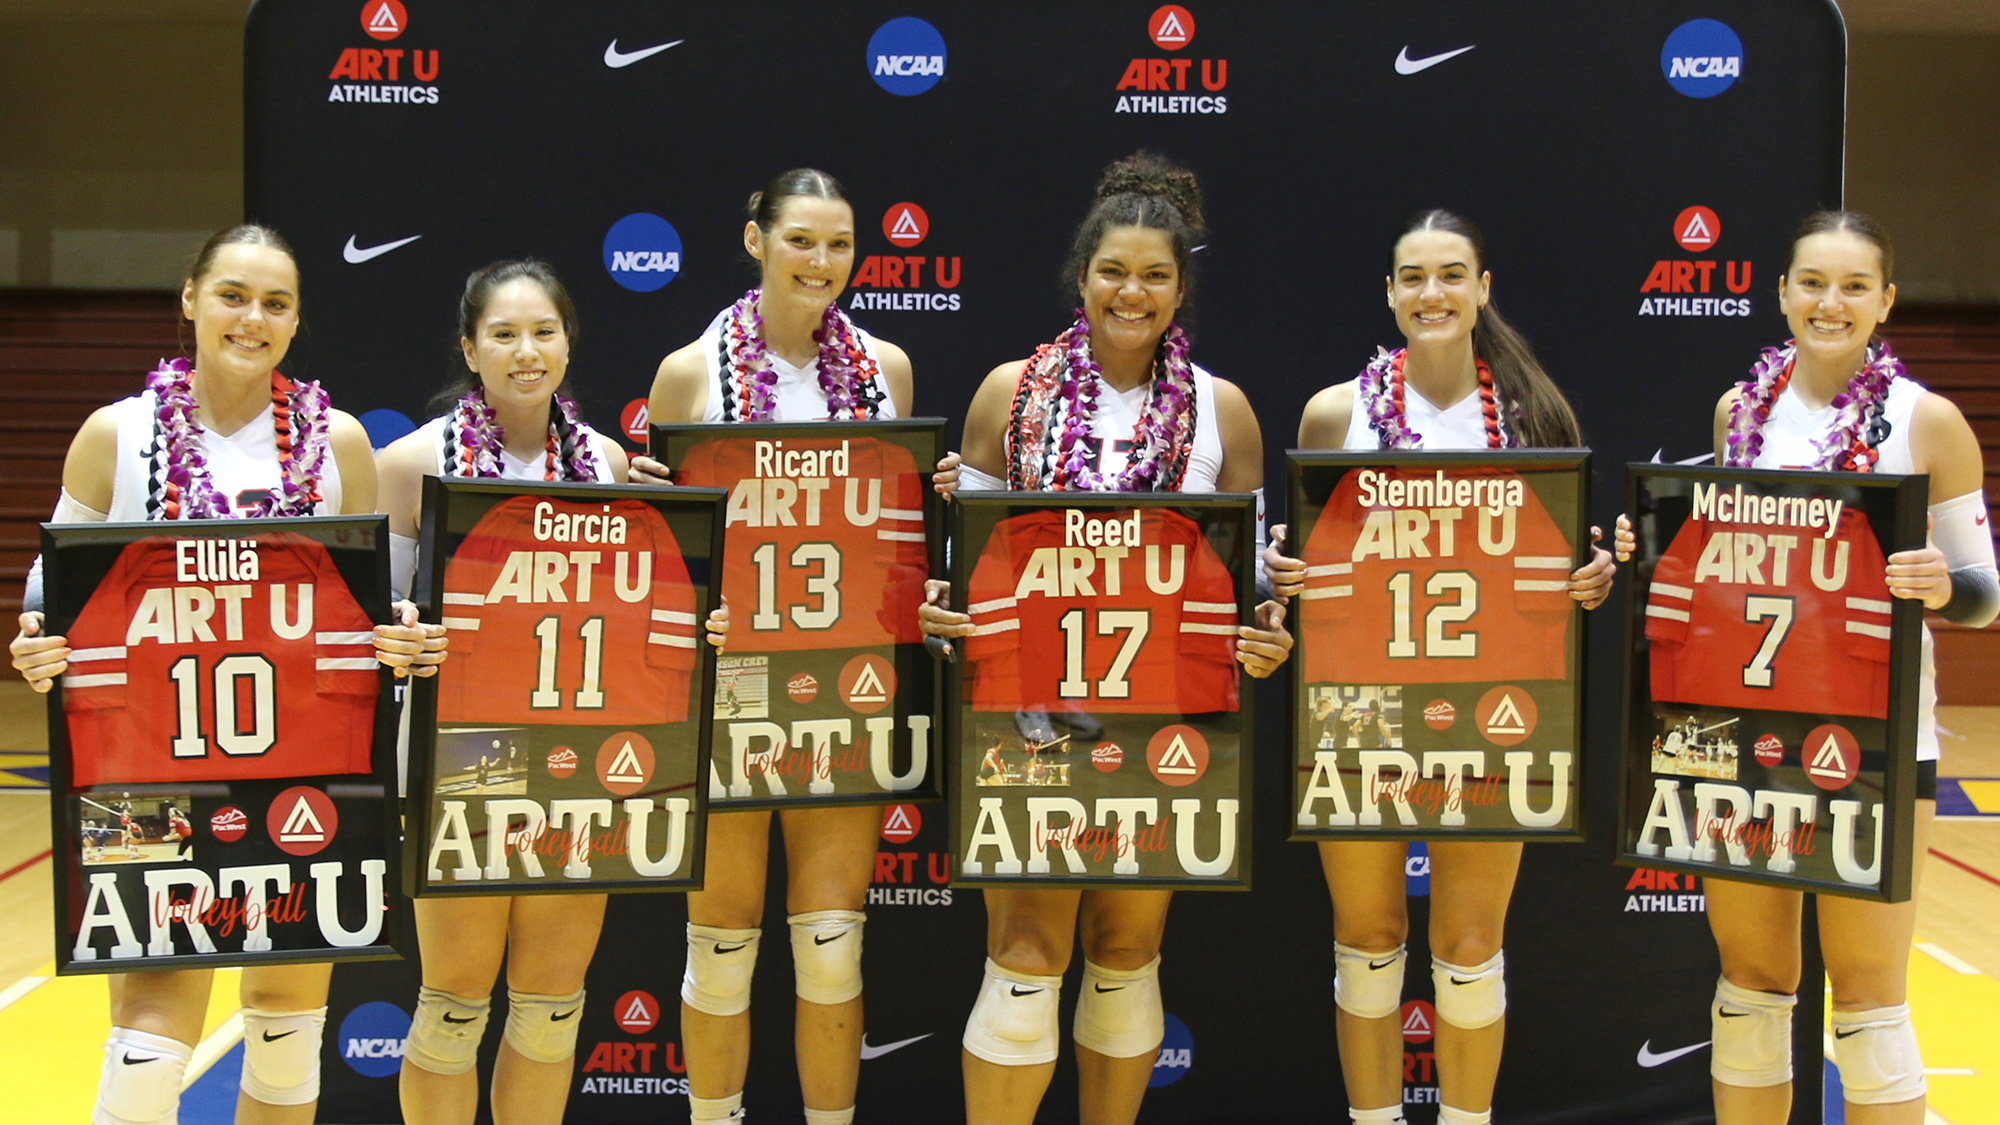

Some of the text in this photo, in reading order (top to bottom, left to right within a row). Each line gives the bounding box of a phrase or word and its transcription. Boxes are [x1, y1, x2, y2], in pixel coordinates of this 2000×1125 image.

[328, 48, 439, 82] ART U
[874, 54, 944, 77] NCAA
[1115, 59, 1228, 92] ART U
[1669, 56, 1740, 78] NCAA
[328, 85, 439, 104] ATHLETICS
[1115, 96, 1227, 114] ATHLETICS
[610, 250, 680, 273] NCAA
[850, 256, 961, 289] ART U
[1639, 260, 1752, 294] ART U
[850, 292, 961, 311] ATHLETICS
[1638, 298, 1751, 317] ATHLETICS
[755, 440, 849, 478] Ricard
[726, 478, 882, 528] ART U
[1357, 470, 1524, 517] Stemberga
[1692, 482, 1843, 540] McInerney
[532, 501, 628, 545] Garcia
[1065, 509, 1141, 547] Reed
[1351, 507, 1517, 562] ART U
[176, 538, 260, 583] Ellilä
[484, 551, 652, 604] ART U
[1014, 544, 1185, 600] ART U
[1694, 532, 1850, 592] ART U
[752, 542, 842, 632] 13
[126, 583, 314, 646] ART U
[1387, 570, 1479, 659] 12
[530, 615, 605, 710] 11
[1057, 609, 1151, 699] 17
[1743, 595, 1796, 689] 7
[169, 653, 276, 760] 10
[709, 715, 931, 797] RT U
[743, 738, 870, 785] Volleyball
[1092, 756, 1121, 764] PacWest
[1297, 750, 1572, 827] ART U
[1370, 771, 1503, 816] Volleyball
[427, 798, 689, 881] ART U
[504, 820, 630, 867] Volleyball
[962, 797, 1240, 876] ART U
[1035, 817, 1169, 863] Volleyball
[1636, 778, 1884, 885] ART U
[1693, 808, 1817, 859] Volleyball
[870, 852, 950, 884] RT U
[73, 859, 386, 961] ART U
[154, 882, 307, 938] Volleyball
[864, 888, 953, 906] HLETICS
[1624, 895, 1706, 912] ATHLETI
[582, 1042, 687, 1074] ART U
[1153, 1048, 1191, 1069] AA
[1403, 1052, 1435, 1083] RT
[581, 1077, 690, 1096] ATHLETICS
